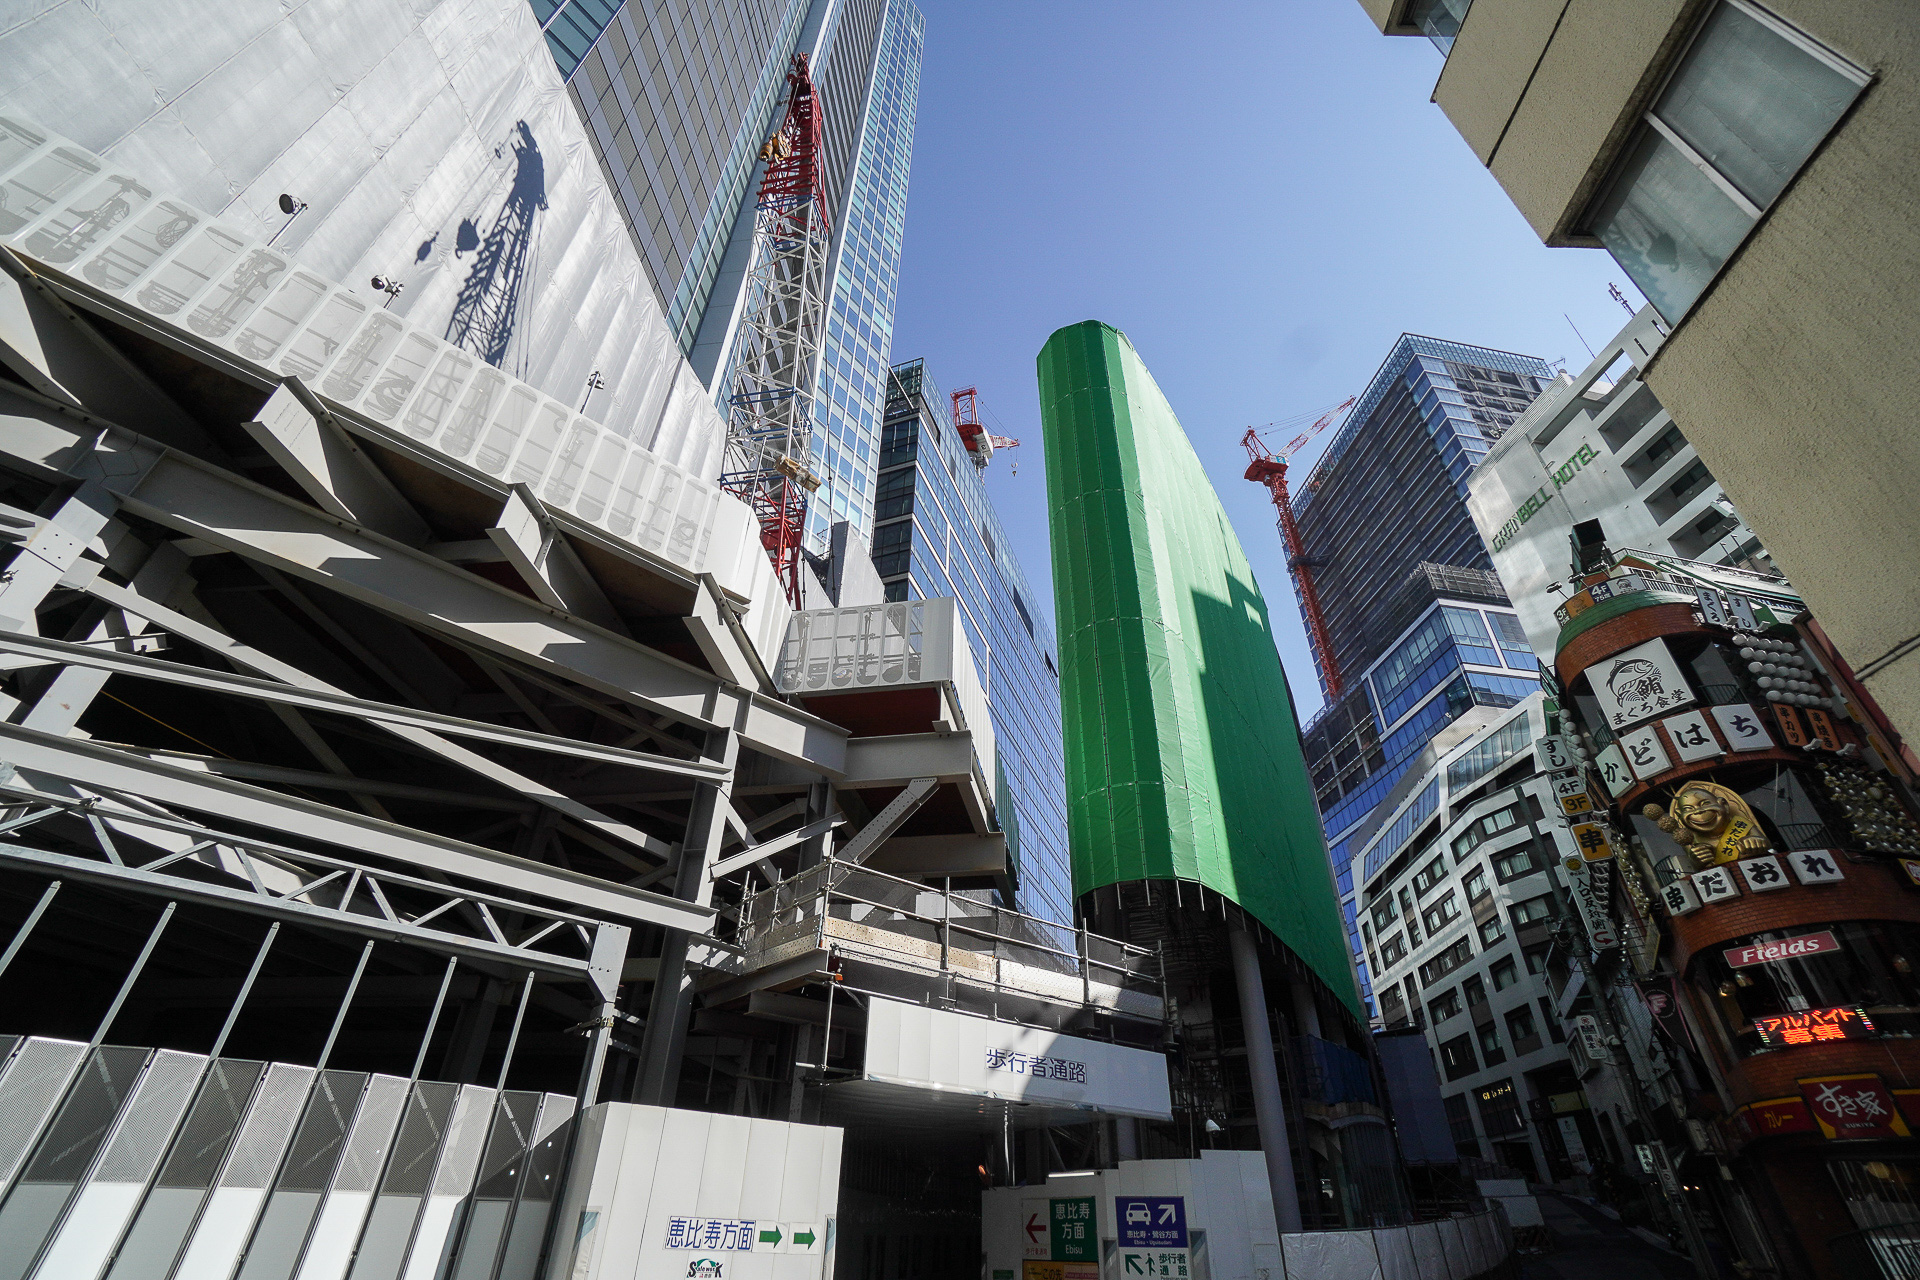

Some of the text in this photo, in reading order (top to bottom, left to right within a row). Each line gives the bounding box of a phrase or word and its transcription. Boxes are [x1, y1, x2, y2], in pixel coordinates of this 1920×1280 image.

[1492, 443, 1601, 553] GRANBELL HOTEL
[1591, 584, 1607, 596] 4F
[1556, 607, 1567, 620] 3F
[1733, 597, 1751, 628] すし
[1635, 677, 1664, 701] 鮪
[1613, 688, 1687, 725] まぐろ食堂
[1543, 739, 1566, 767] すし
[1558, 780, 1579, 794] 4F
[1565, 796, 1587, 811] 3F
[1579, 828, 1604, 854] 串
[1721, 820, 1748, 857] 串だおれ
[1666, 854, 1835, 912] 串だおれ
[1742, 939, 1820, 963] Fields
[1762, 1008, 1856, 1031] アルバイト
[1780, 1023, 1846, 1044] 募集
[986, 1048, 1086, 1084] 歩行者通路
[1815, 1083, 1888, 1121] すき家
[1764, 1110, 1794, 1129] カレー
[1055, 1202, 1090, 1220] 恵比寿
[666, 1218, 755, 1251] 恵比寿方面
[1062, 1222, 1085, 1239] 方面
[1065, 1244, 1083, 1255] Ebisu
[1158, 1253, 1186, 1264] 歩行者
